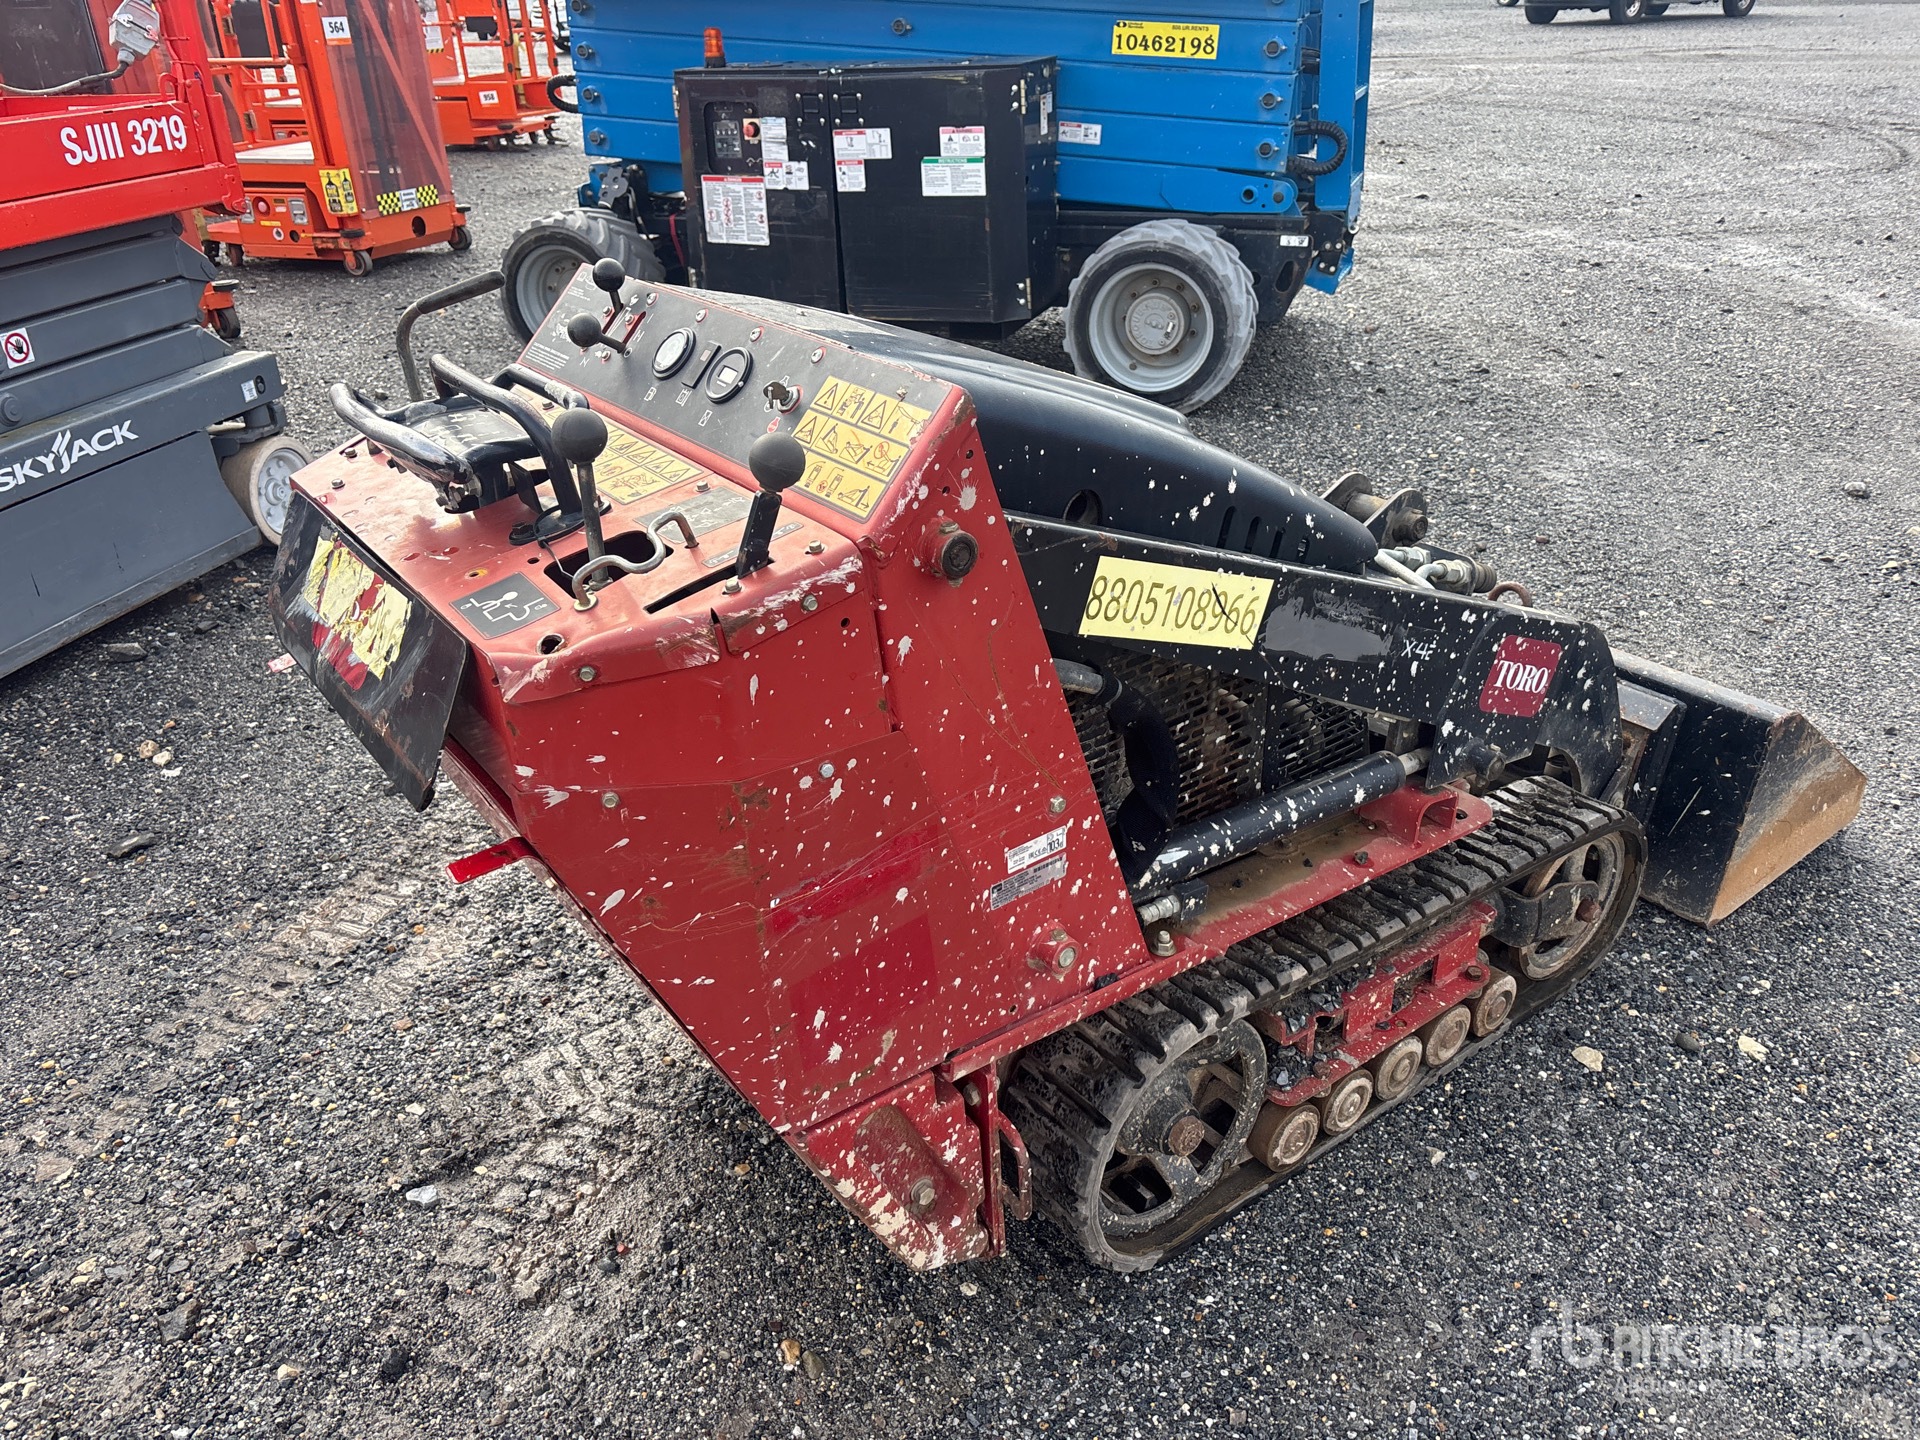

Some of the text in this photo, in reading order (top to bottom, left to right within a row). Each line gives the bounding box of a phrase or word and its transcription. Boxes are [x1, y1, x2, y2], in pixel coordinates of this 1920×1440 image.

[328, 21, 345, 34] 564
[1115, 33, 1216, 56] 10462198
[127, 114, 188, 156] 3219
[0, 419, 139, 492] SKYJACK
[1085, 575, 1260, 636] 8805108966
[1493, 659, 1549, 694] TORO
